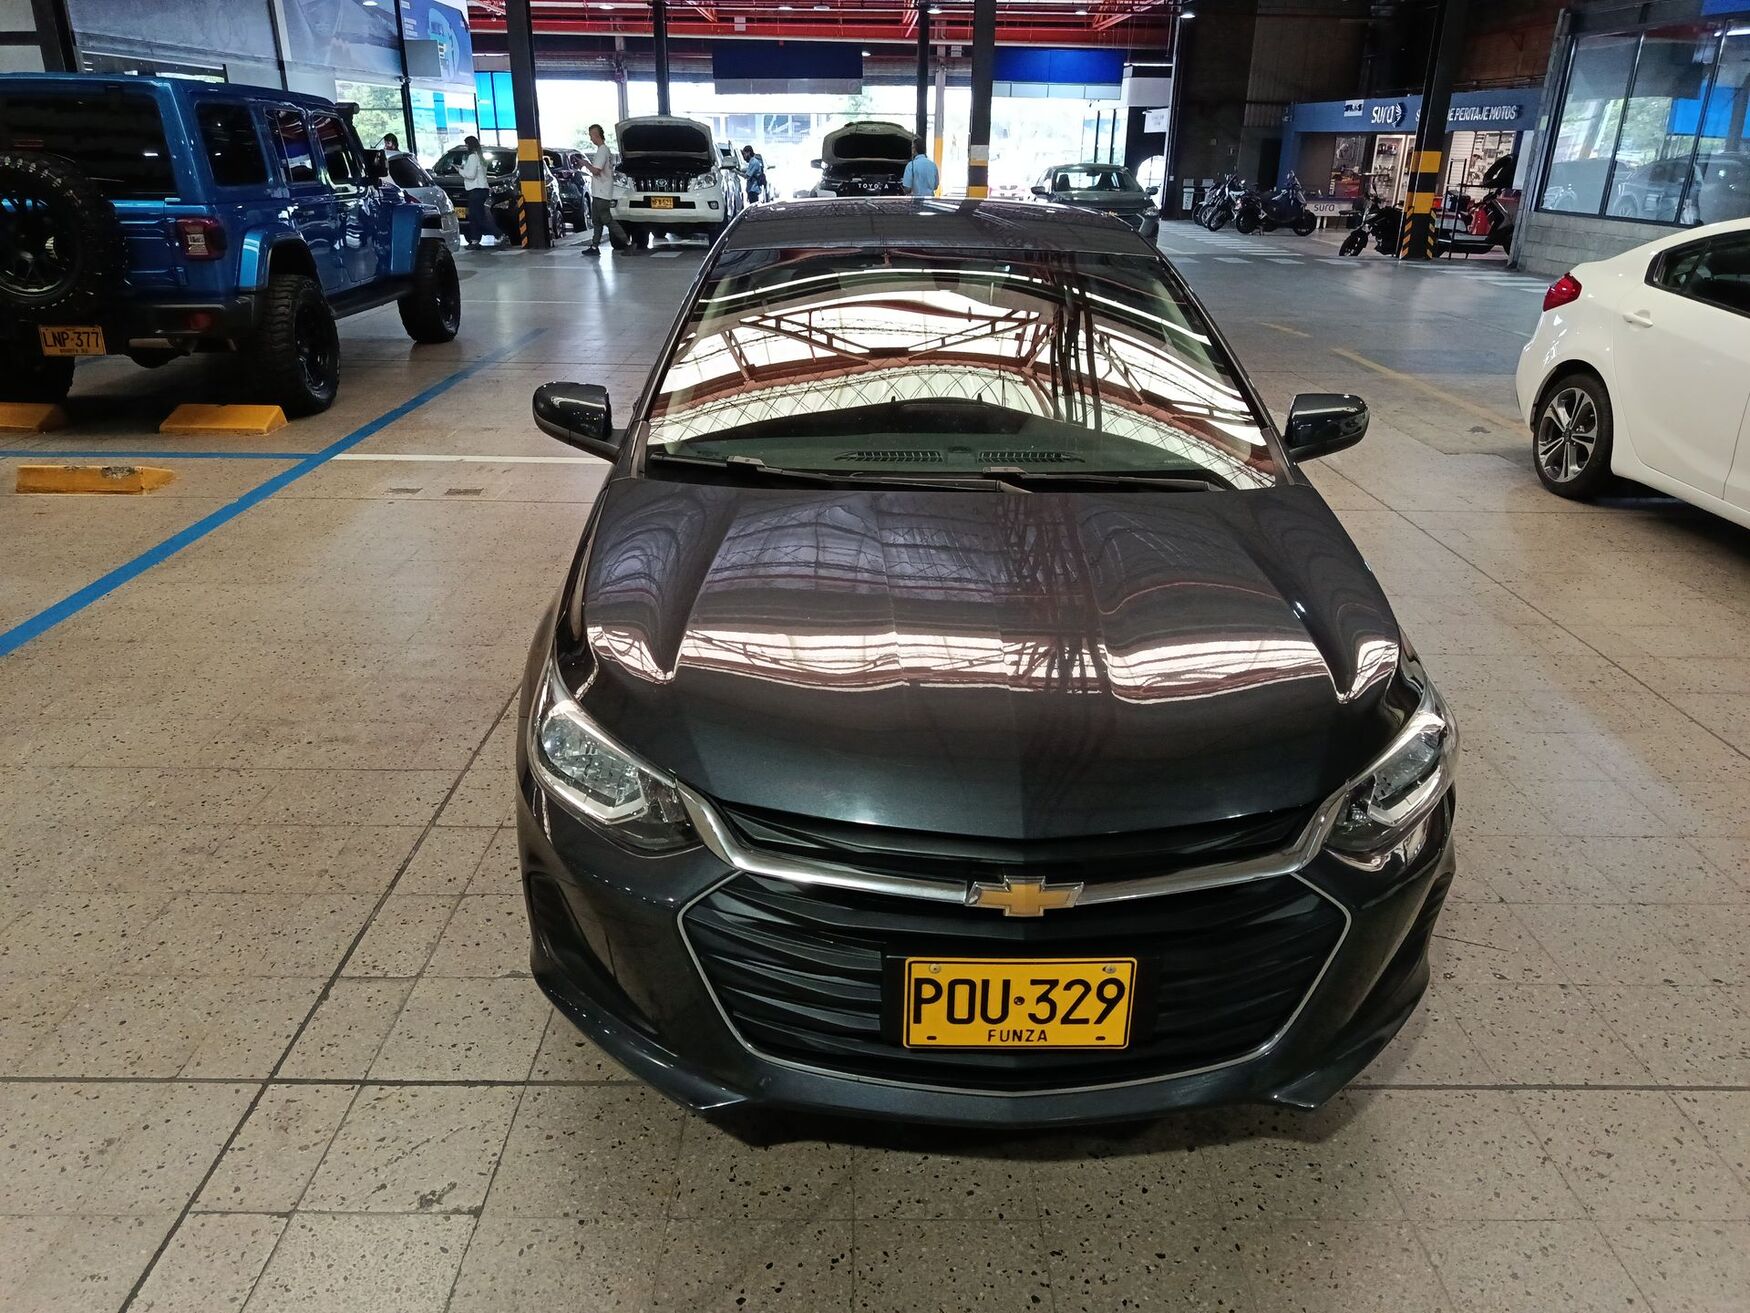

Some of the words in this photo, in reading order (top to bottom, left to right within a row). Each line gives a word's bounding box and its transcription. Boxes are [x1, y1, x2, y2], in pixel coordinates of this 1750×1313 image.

[1371, 105, 1395, 124] sura
[1454, 106, 1489, 121] PERITAJE
[1489, 105, 1517, 120] MOTOS
[1313, 203, 1335, 212] sura
[987, 1029, 1048, 1042] FUNZA
